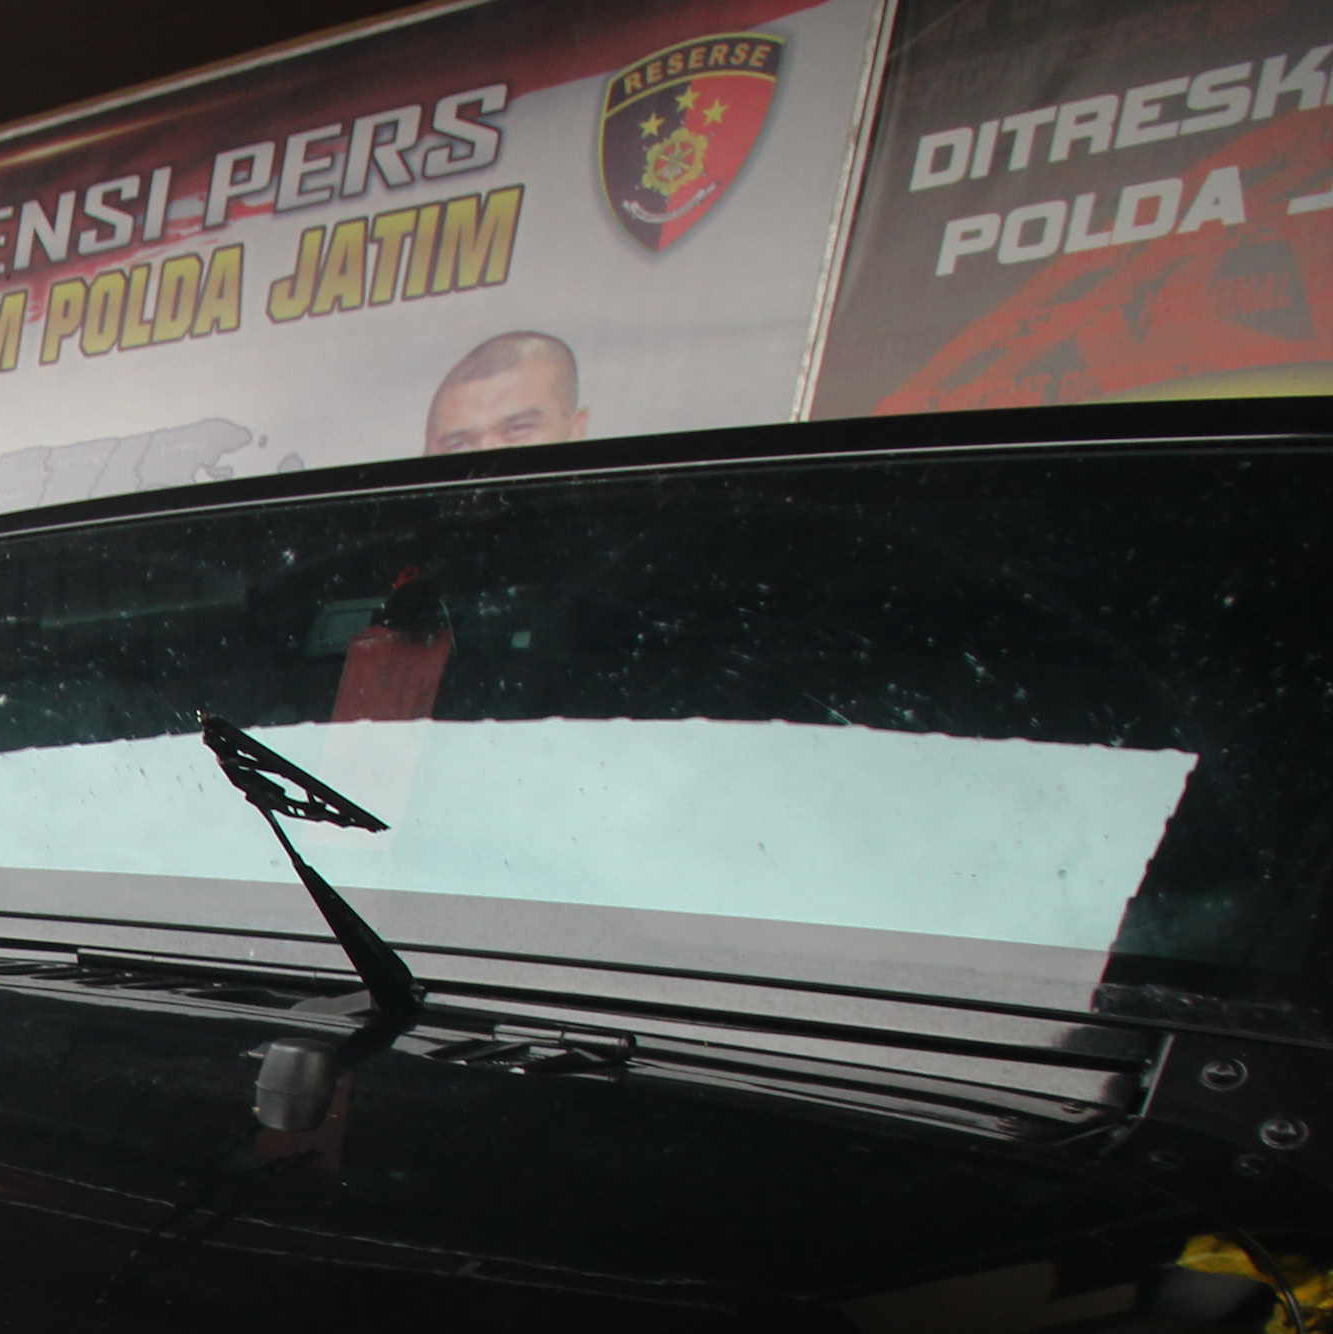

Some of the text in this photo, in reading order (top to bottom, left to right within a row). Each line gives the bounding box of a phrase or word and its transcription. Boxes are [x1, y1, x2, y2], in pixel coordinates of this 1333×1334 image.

[623, 42, 771, 95] RESERSE
[909, 44, 1333, 192] DITRESK
[205, 83, 508, 228] PERS
[935, 166, 1246, 277] POLDA
[39, 244, 245, 366] POLDA
[266, 186, 524, 323] JATIM
